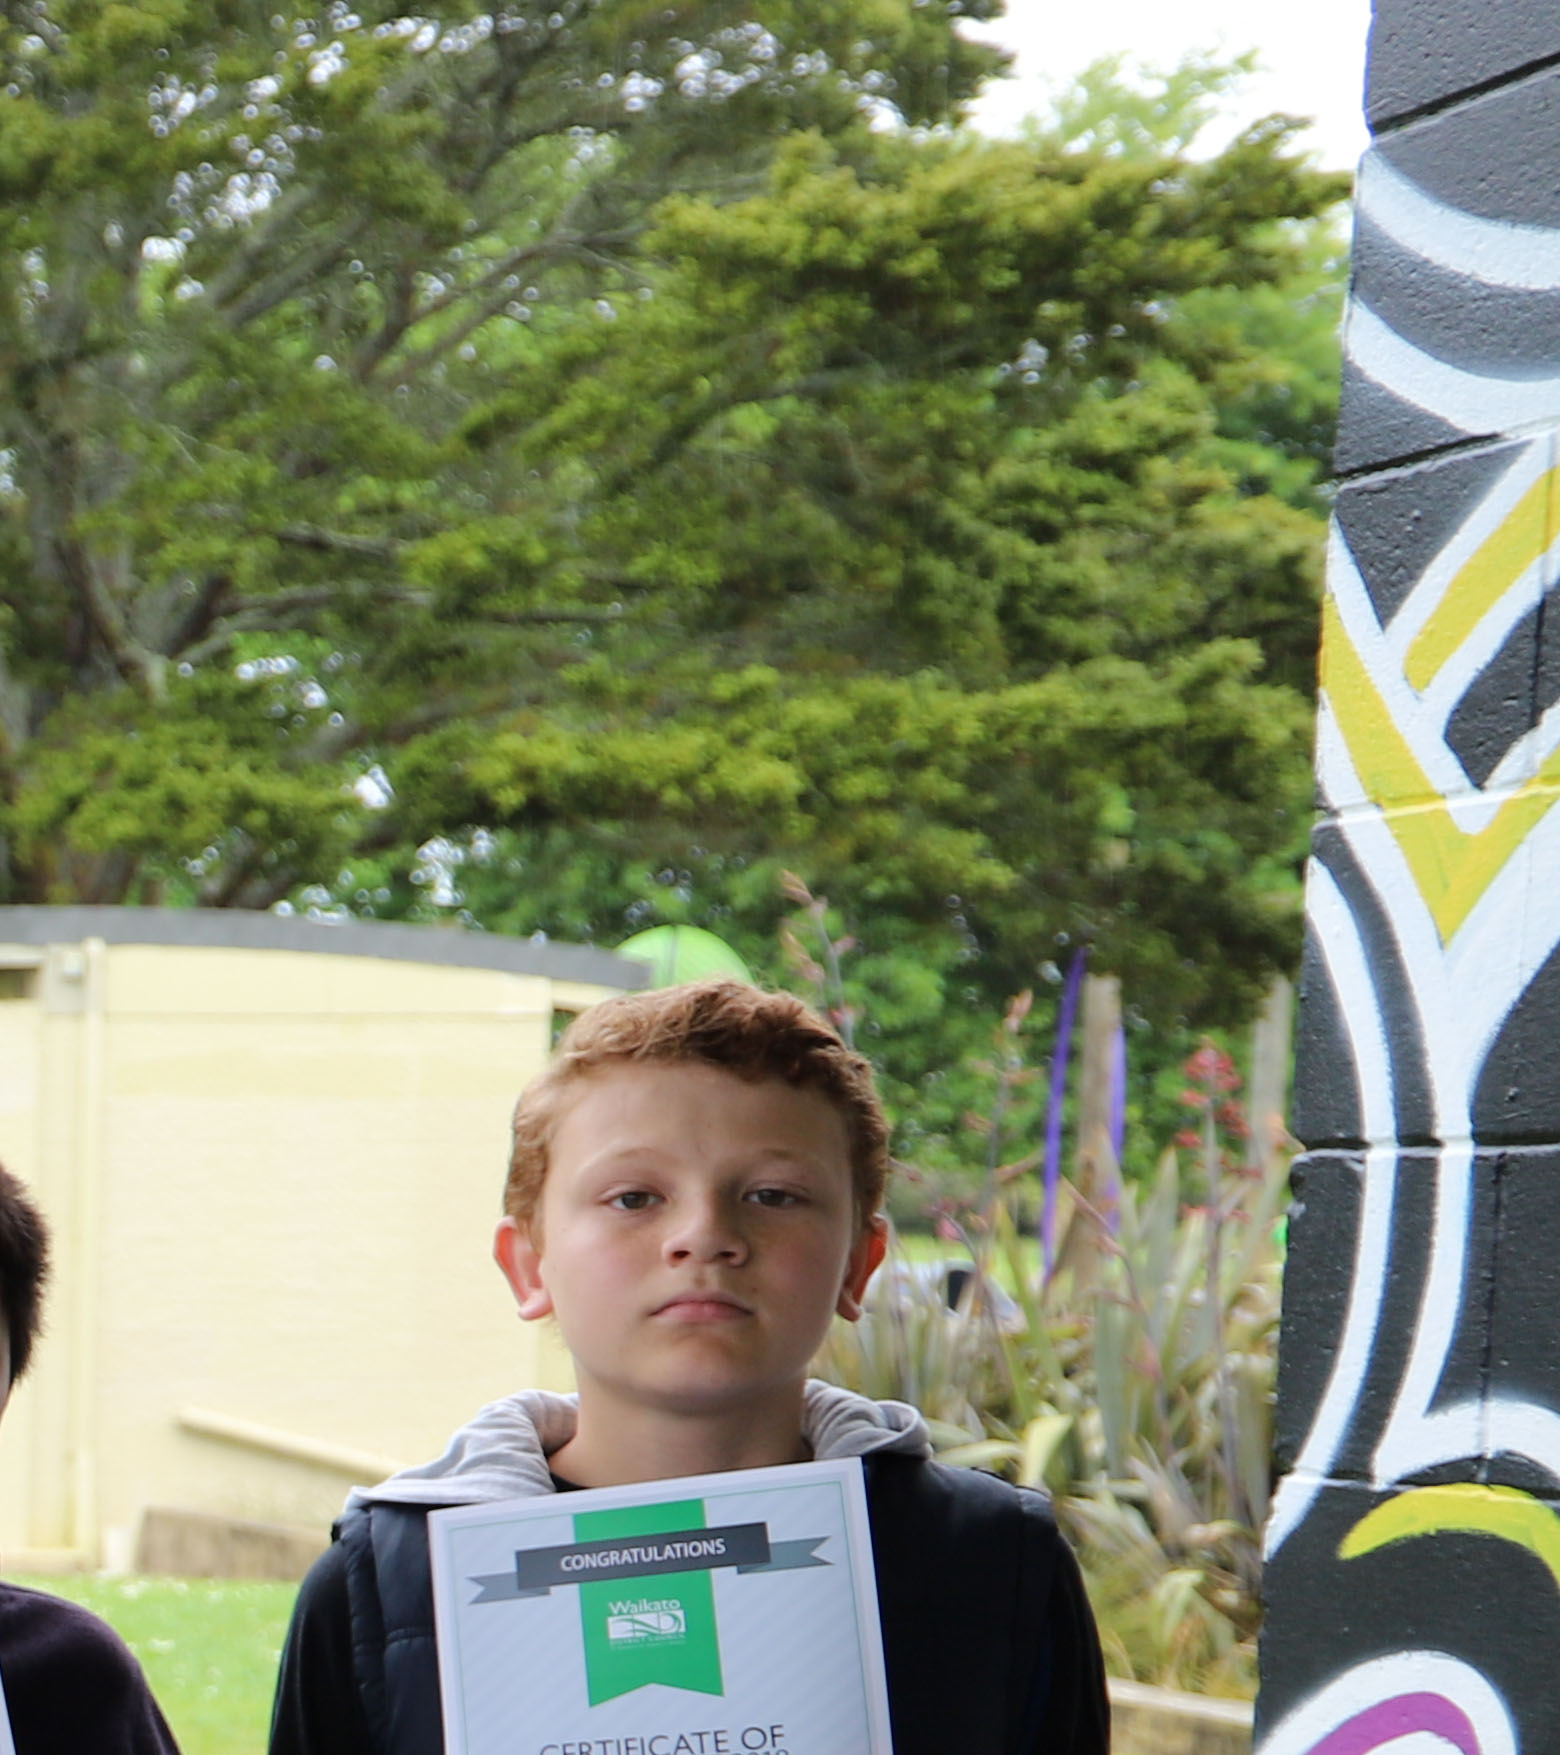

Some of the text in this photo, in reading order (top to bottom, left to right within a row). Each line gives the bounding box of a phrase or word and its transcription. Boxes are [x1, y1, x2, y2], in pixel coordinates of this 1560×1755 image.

[559, 1538, 725, 1571] CONGRATULATIONS
[608, 1598, 680, 1615] Waikato
[740, 1724, 784, 1750] OF
